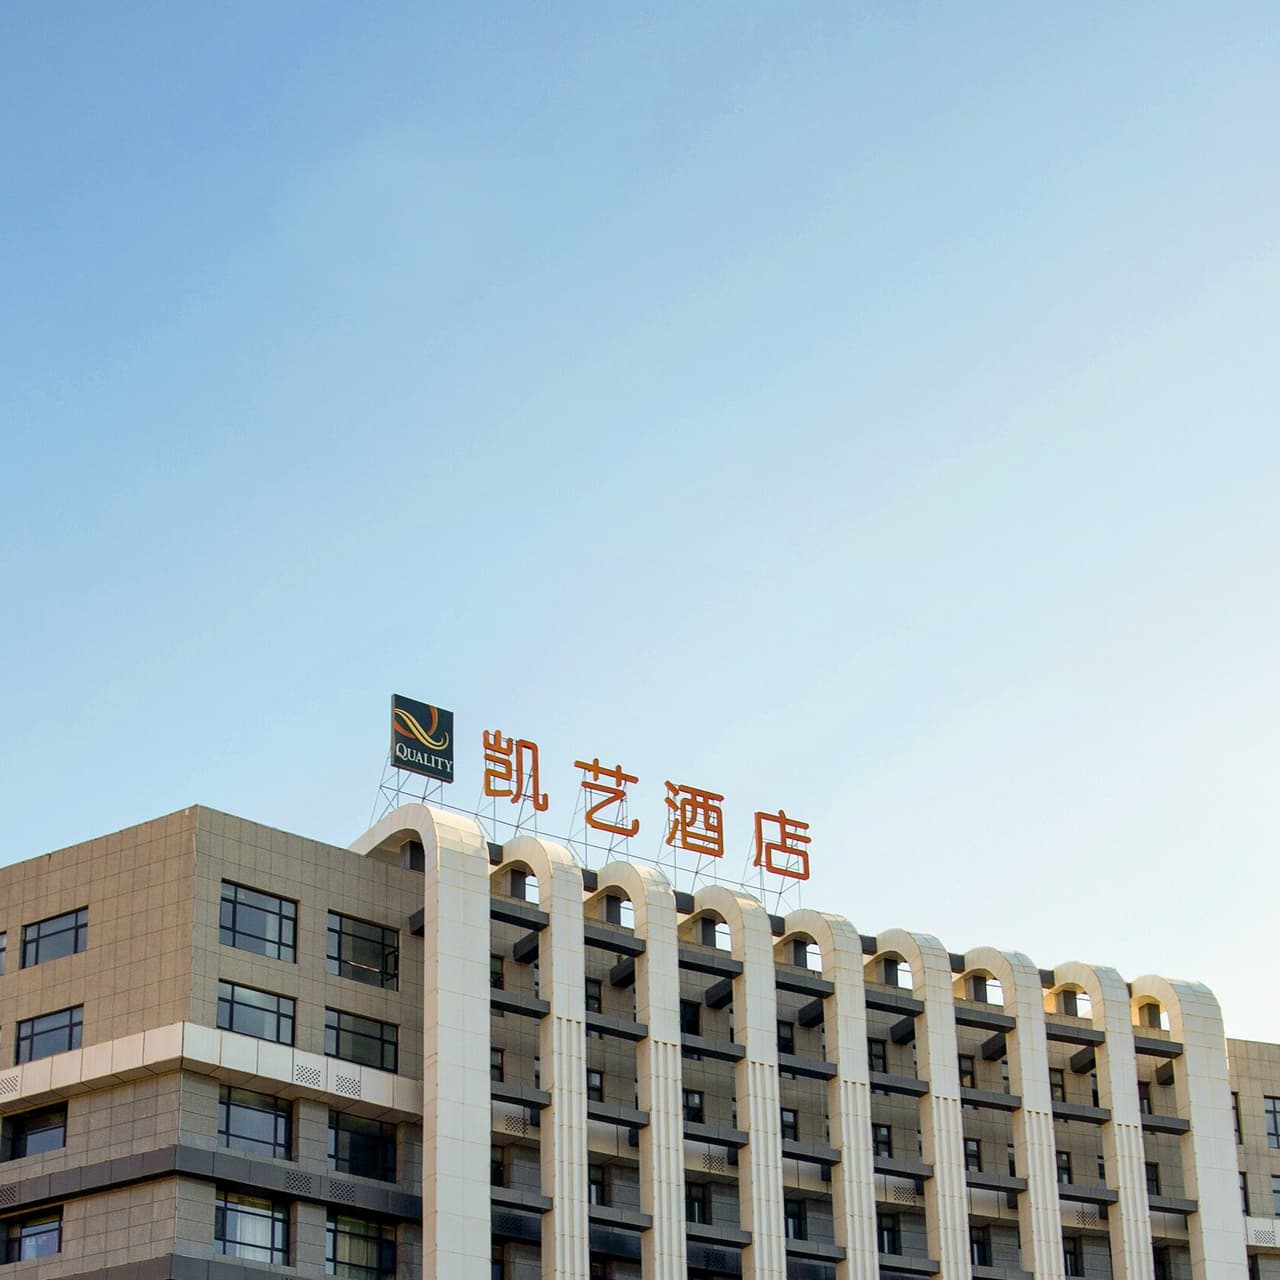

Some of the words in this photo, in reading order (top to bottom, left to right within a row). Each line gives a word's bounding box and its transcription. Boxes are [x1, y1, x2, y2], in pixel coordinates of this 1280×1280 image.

[395, 741, 454, 773] QUALITY
[483, 729, 813, 881] 凯艺酒店
